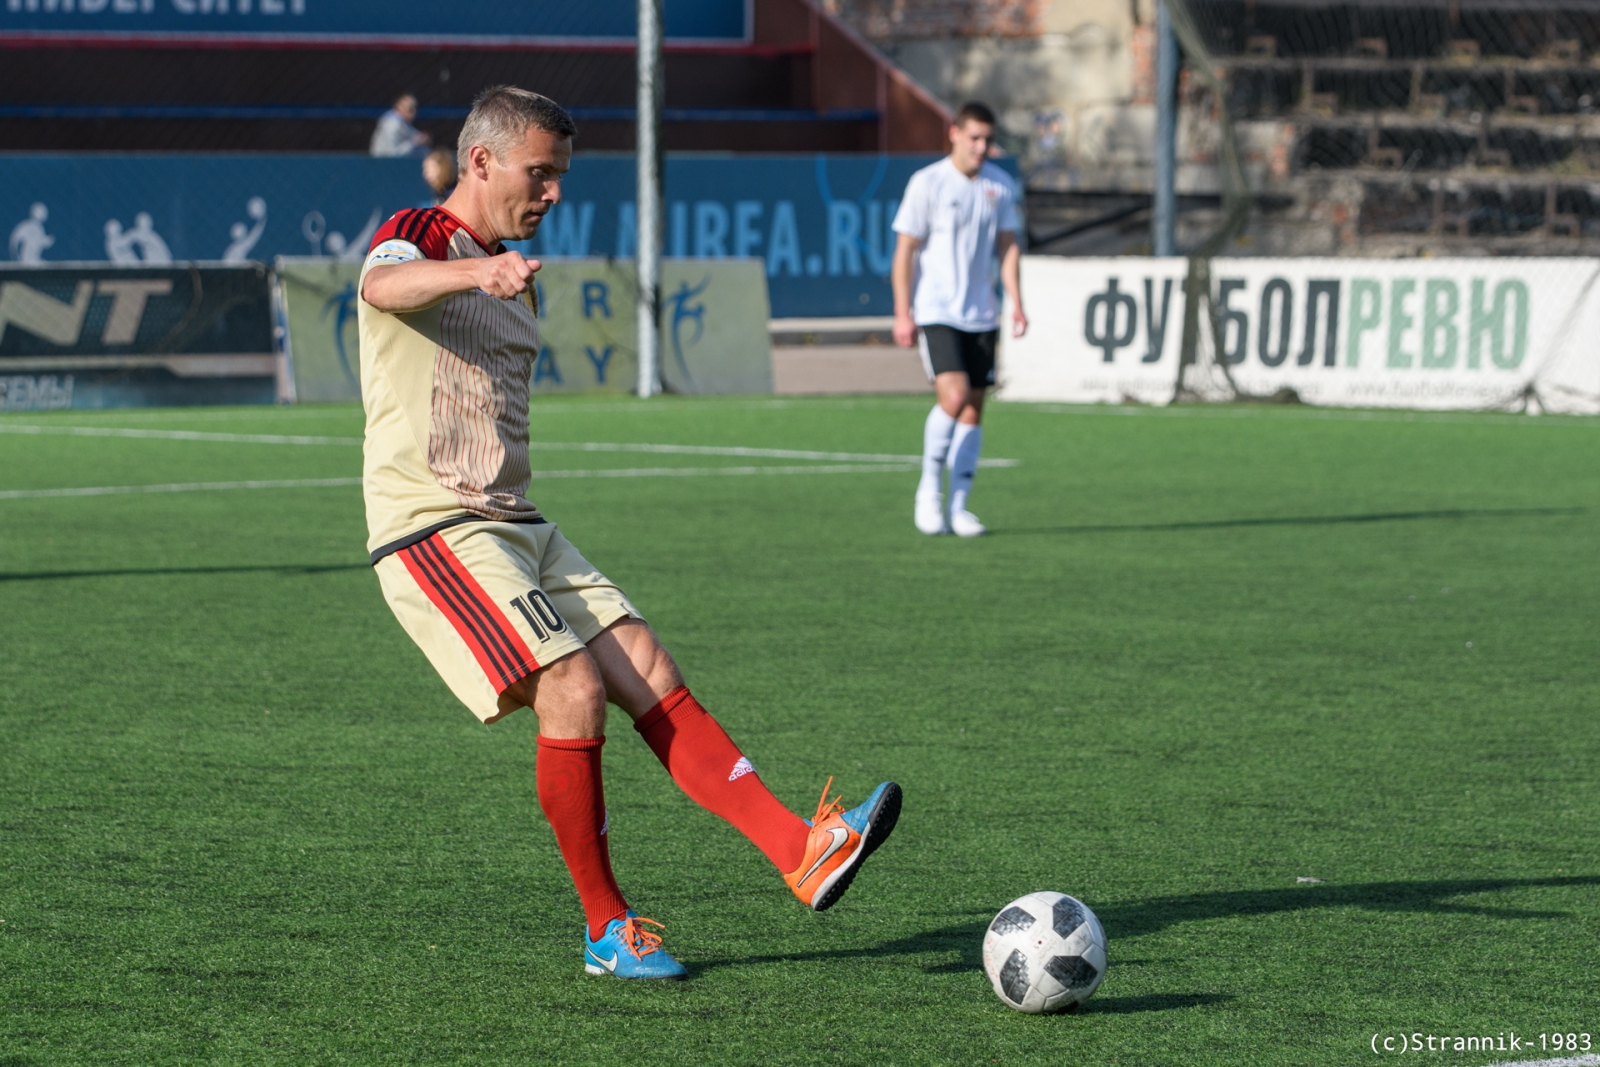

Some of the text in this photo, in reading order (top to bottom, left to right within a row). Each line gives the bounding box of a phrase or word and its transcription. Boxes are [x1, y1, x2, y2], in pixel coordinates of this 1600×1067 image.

[537, 280, 613, 319] IR
[1084, 276, 1530, 370] ФУБОЛРЕВЮ
[533, 345, 614, 385] AY
[509, 589, 567, 644] 10
